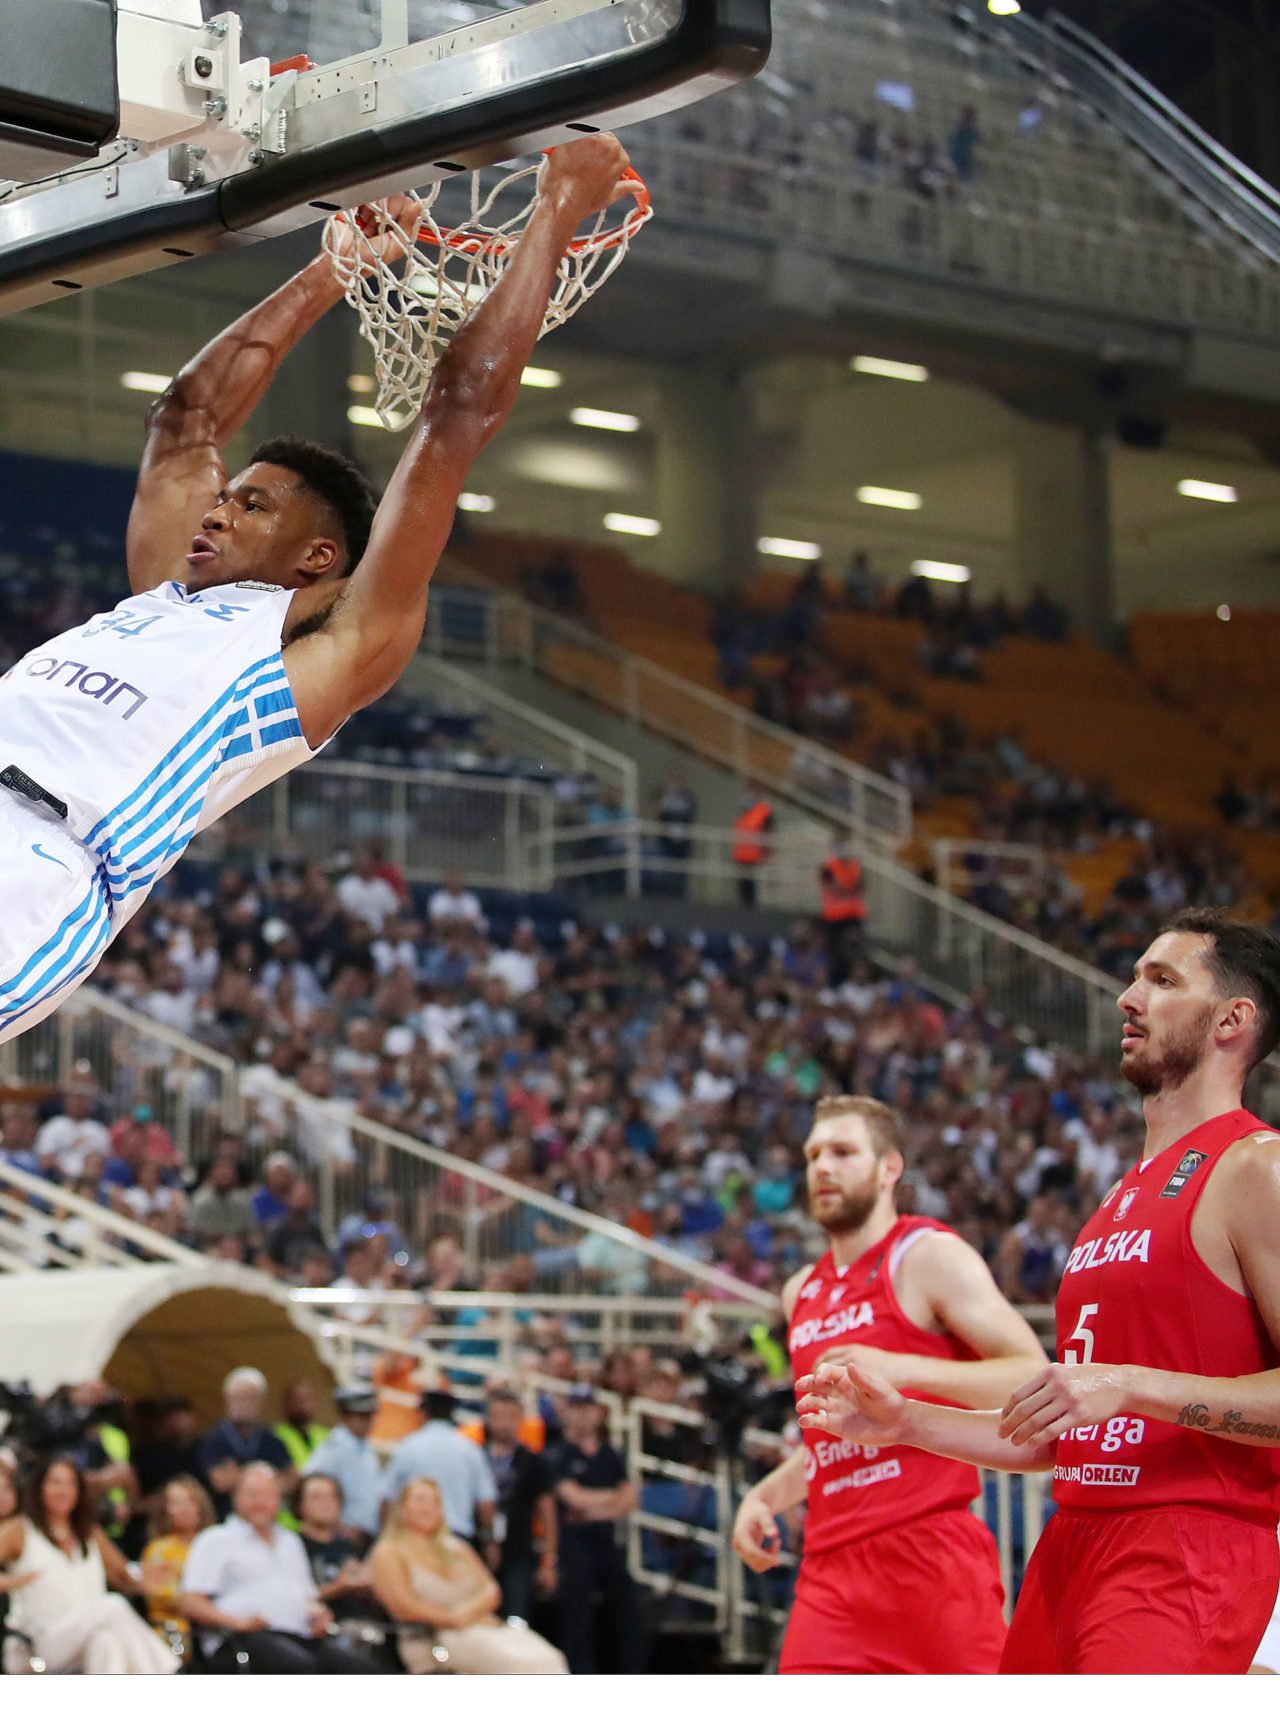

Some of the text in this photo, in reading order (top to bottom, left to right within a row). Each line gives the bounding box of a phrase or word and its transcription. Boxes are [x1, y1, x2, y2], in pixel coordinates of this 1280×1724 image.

[81, 609, 164, 640] 34
[1066, 1229, 1152, 1274] POLSKA
[1064, 1303, 1099, 1366] 5
[1084, 1466, 1135, 1483] ORLEN
